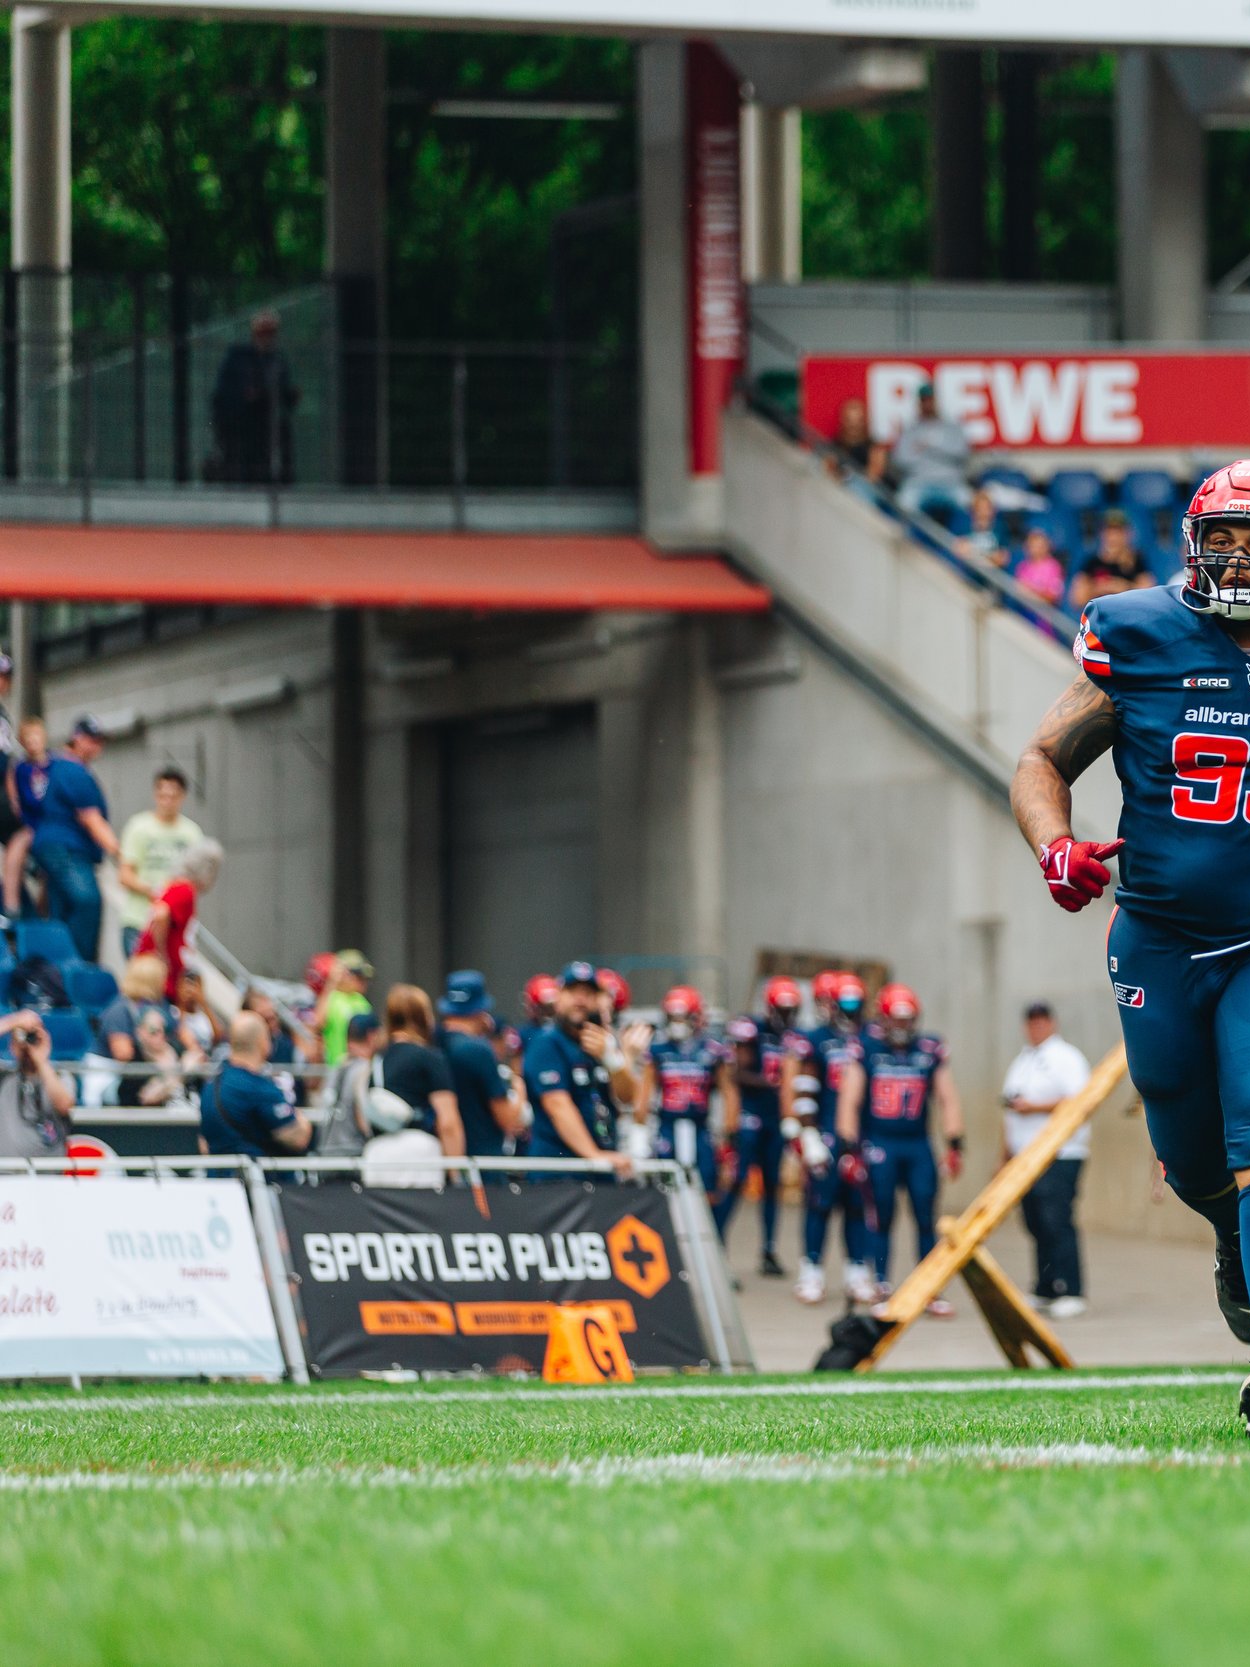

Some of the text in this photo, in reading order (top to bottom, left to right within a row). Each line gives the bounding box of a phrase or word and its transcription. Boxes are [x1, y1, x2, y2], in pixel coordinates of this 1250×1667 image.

[867, 360, 1143, 443] REWE
[303, 1231, 612, 1282] SPORTLER PLUS
[583, 1317, 617, 1378] G
